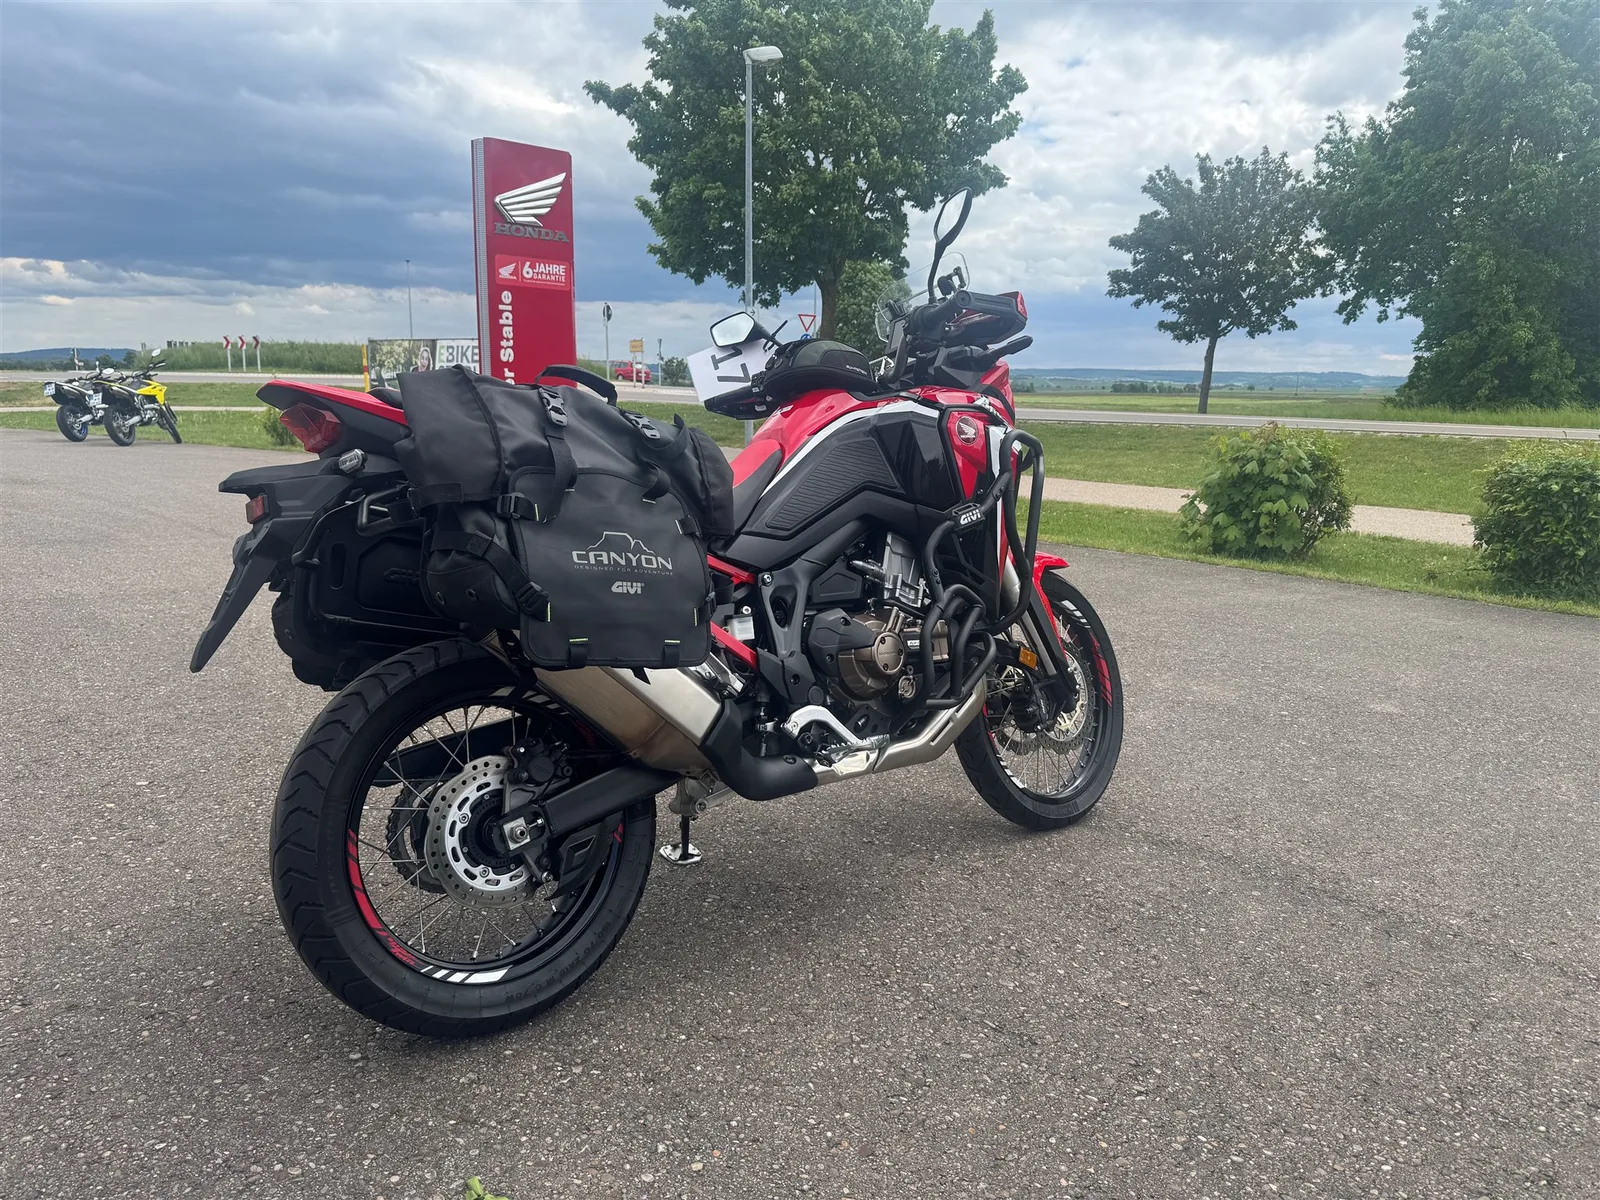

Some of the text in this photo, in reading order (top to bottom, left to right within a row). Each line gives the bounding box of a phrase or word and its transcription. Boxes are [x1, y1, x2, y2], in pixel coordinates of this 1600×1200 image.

[495, 223, 569, 243] HONDA
[523, 261, 566, 279] 6 JAHRE
[533, 273, 566, 283] GARANTIE
[499, 290, 514, 363] Stable
[438, 345, 479, 363] EBIKE
[960, 509, 981, 525] GIVI
[572, 550, 673, 570] CANYON
[634, 568, 673, 576] ADVENTURE
[611, 581, 642, 594] GIVI
